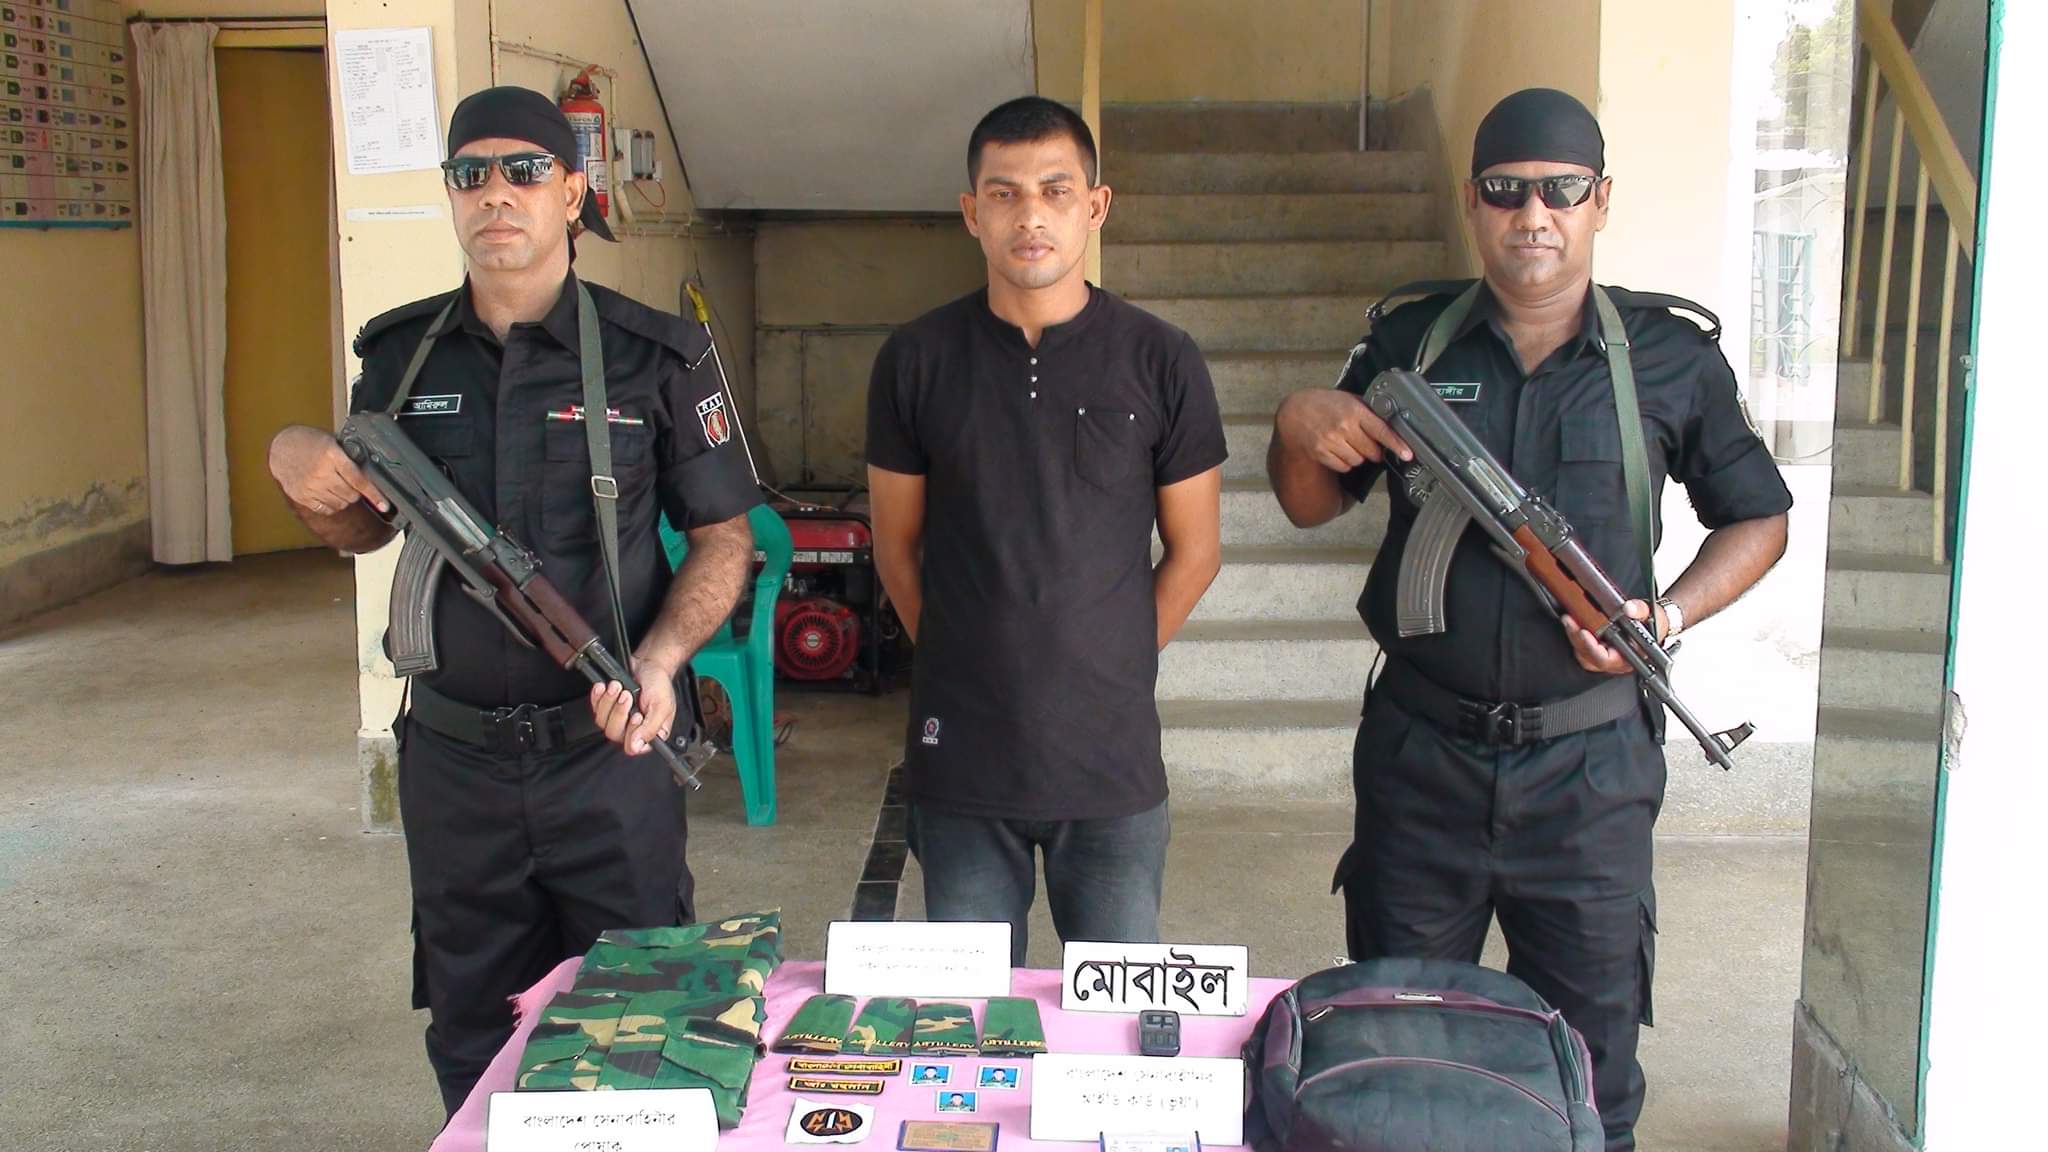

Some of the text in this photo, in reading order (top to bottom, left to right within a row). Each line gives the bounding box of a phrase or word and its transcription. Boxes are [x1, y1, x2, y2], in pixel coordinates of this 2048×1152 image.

[1073, 947, 1235, 1012] মোবাইল
[782, 1032, 842, 1044] ARTILLERY
[981, 1039, 1042, 1048] ARTILLERY
[912, 1040, 975, 1049] ARTILLERY
[522, 1114, 588, 1128] বাংলাদেশ
